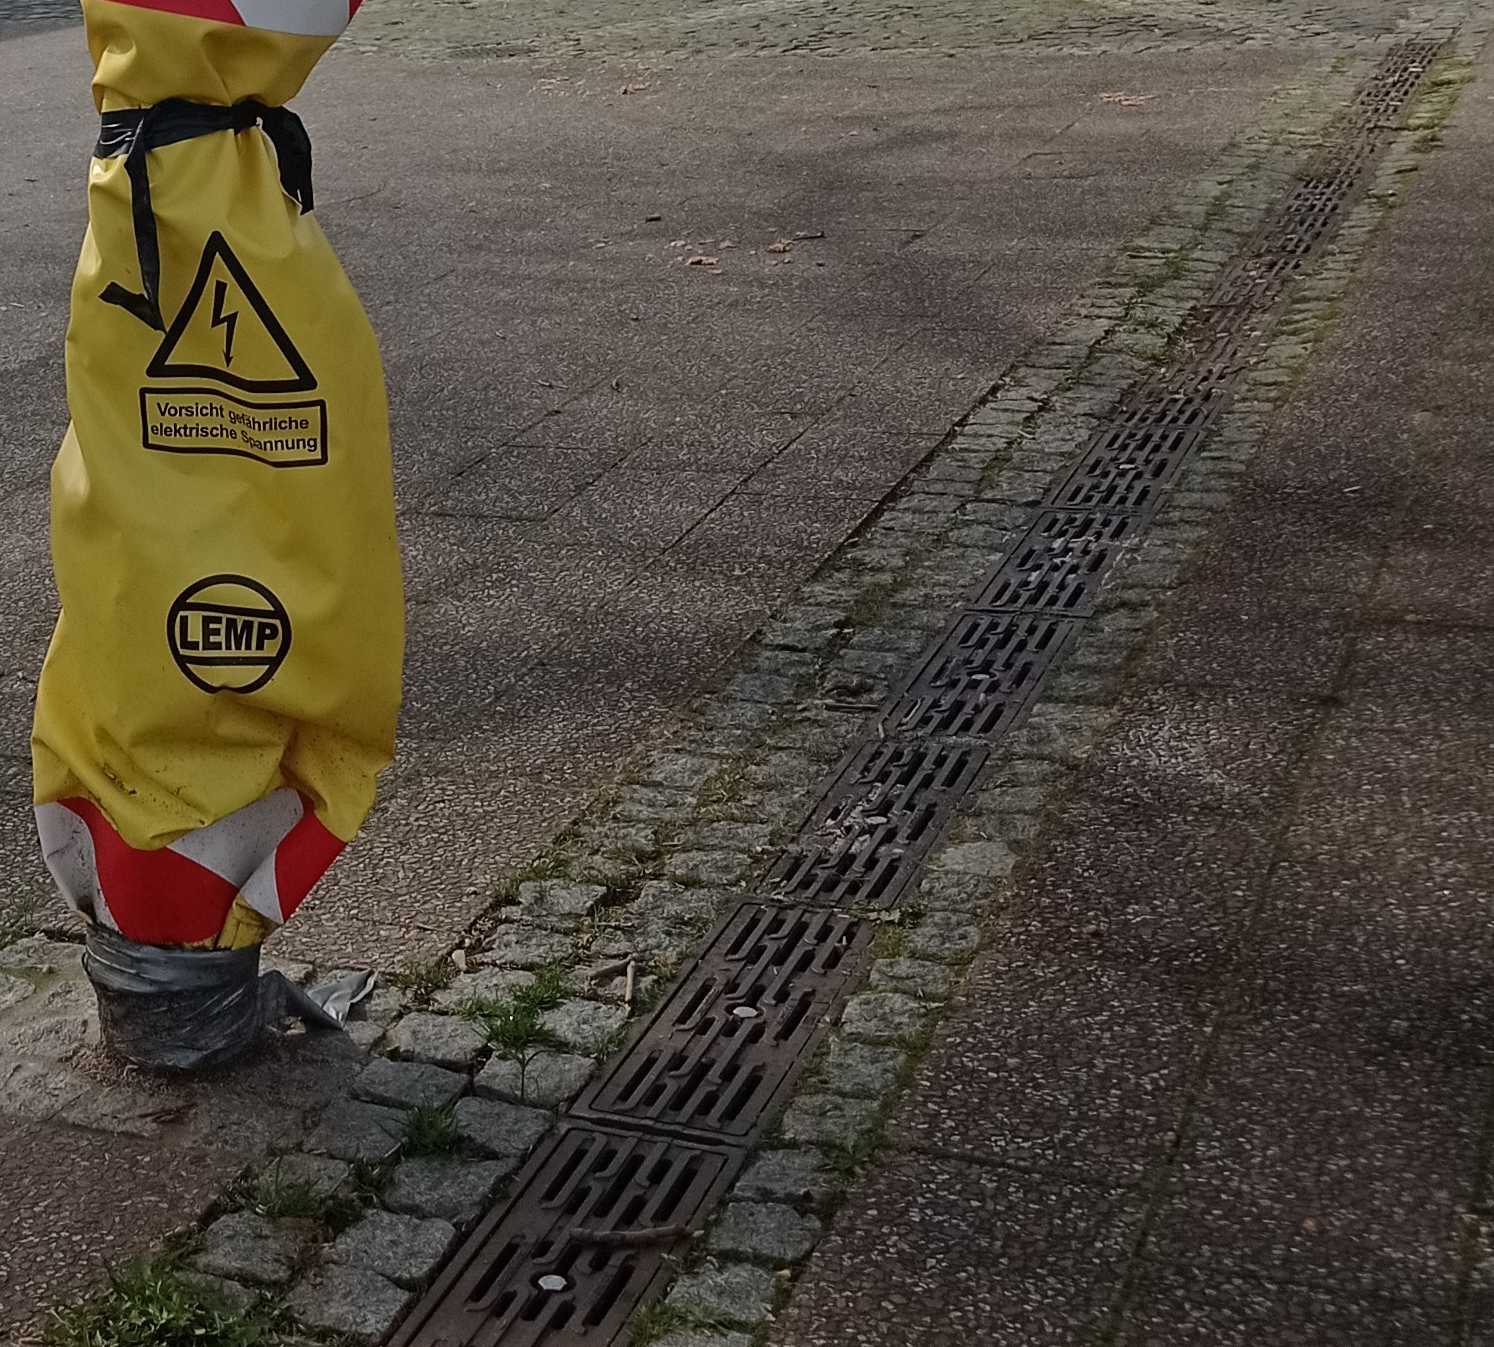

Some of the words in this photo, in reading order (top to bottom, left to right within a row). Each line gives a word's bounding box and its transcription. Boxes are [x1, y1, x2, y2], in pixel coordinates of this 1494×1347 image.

[157, 403, 225, 418] Vorsicht
[229, 411, 309, 432] gefährliche
[151, 423, 237, 439] elektrische
[241, 431, 318, 451] Spannung
[180, 615, 279, 651] LEMP
